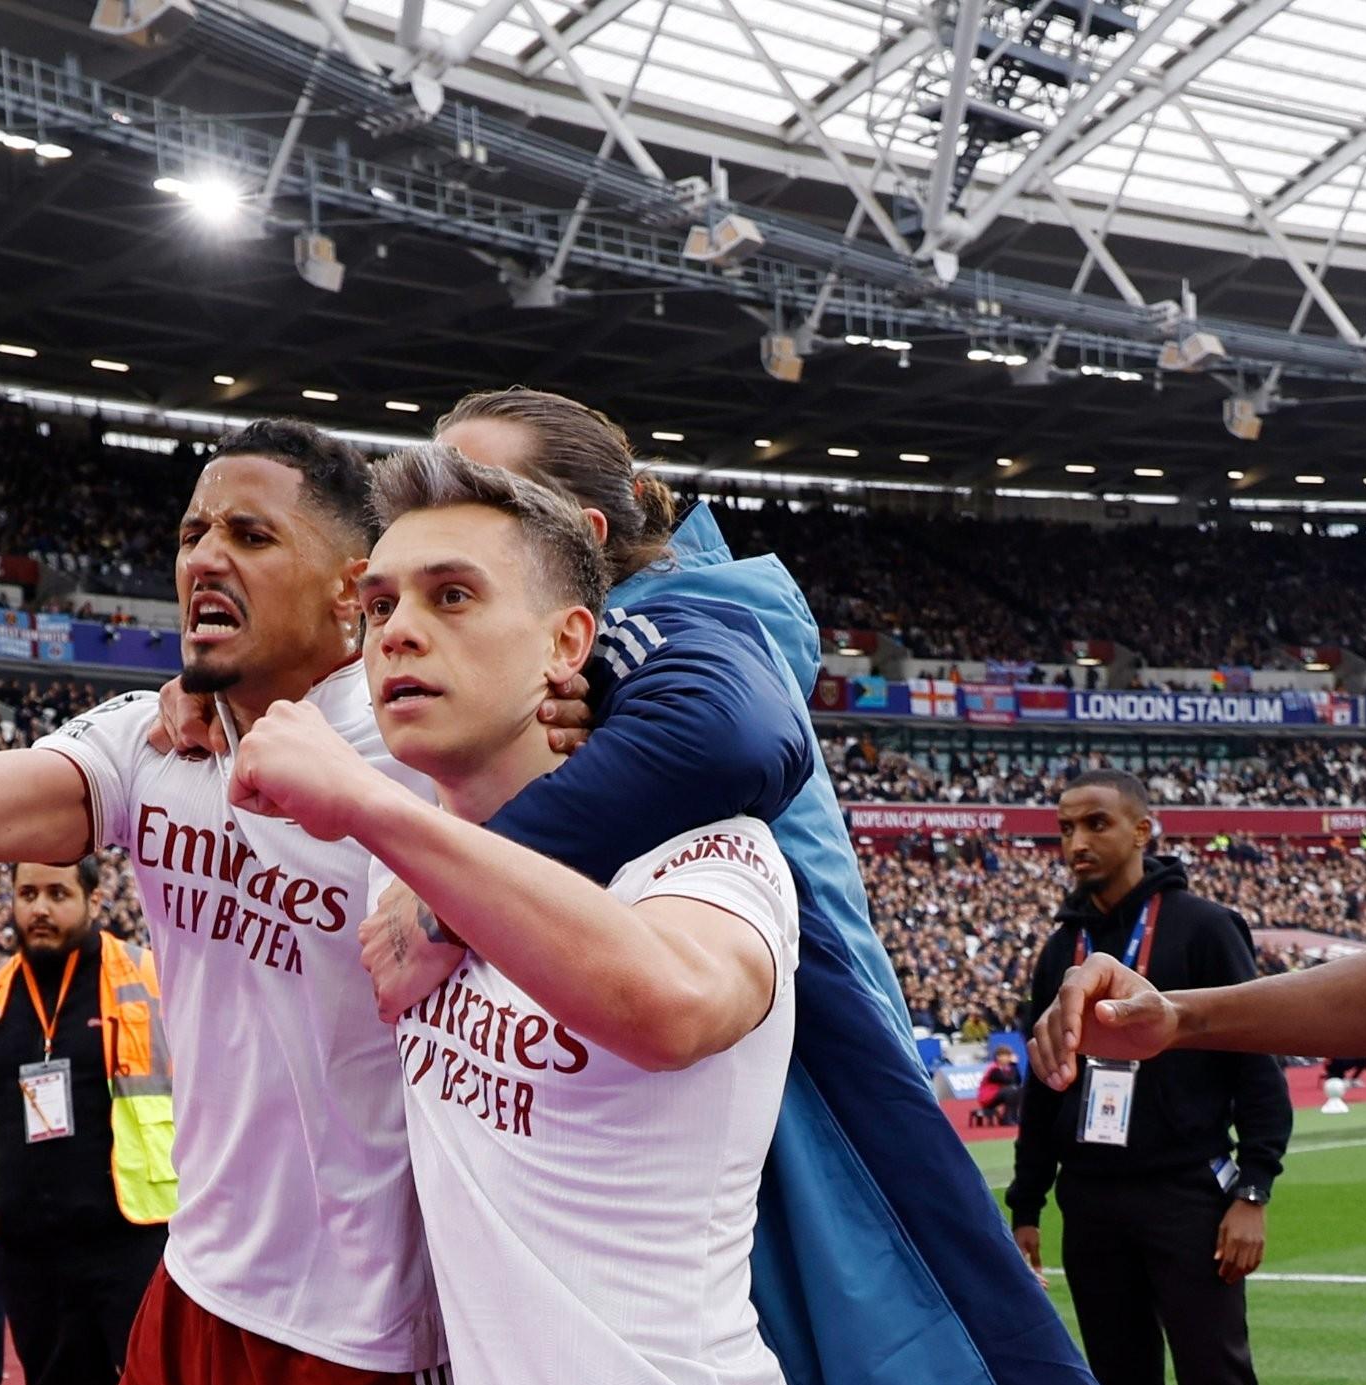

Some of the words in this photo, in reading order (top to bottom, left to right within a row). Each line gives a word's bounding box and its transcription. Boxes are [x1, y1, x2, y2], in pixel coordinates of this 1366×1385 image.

[1075, 694, 1175, 721] LONDON
[1178, 696, 1284, 723] STADIUM
[851, 810, 898, 828] ROPEAN
[163, 882, 208, 933] FLY
